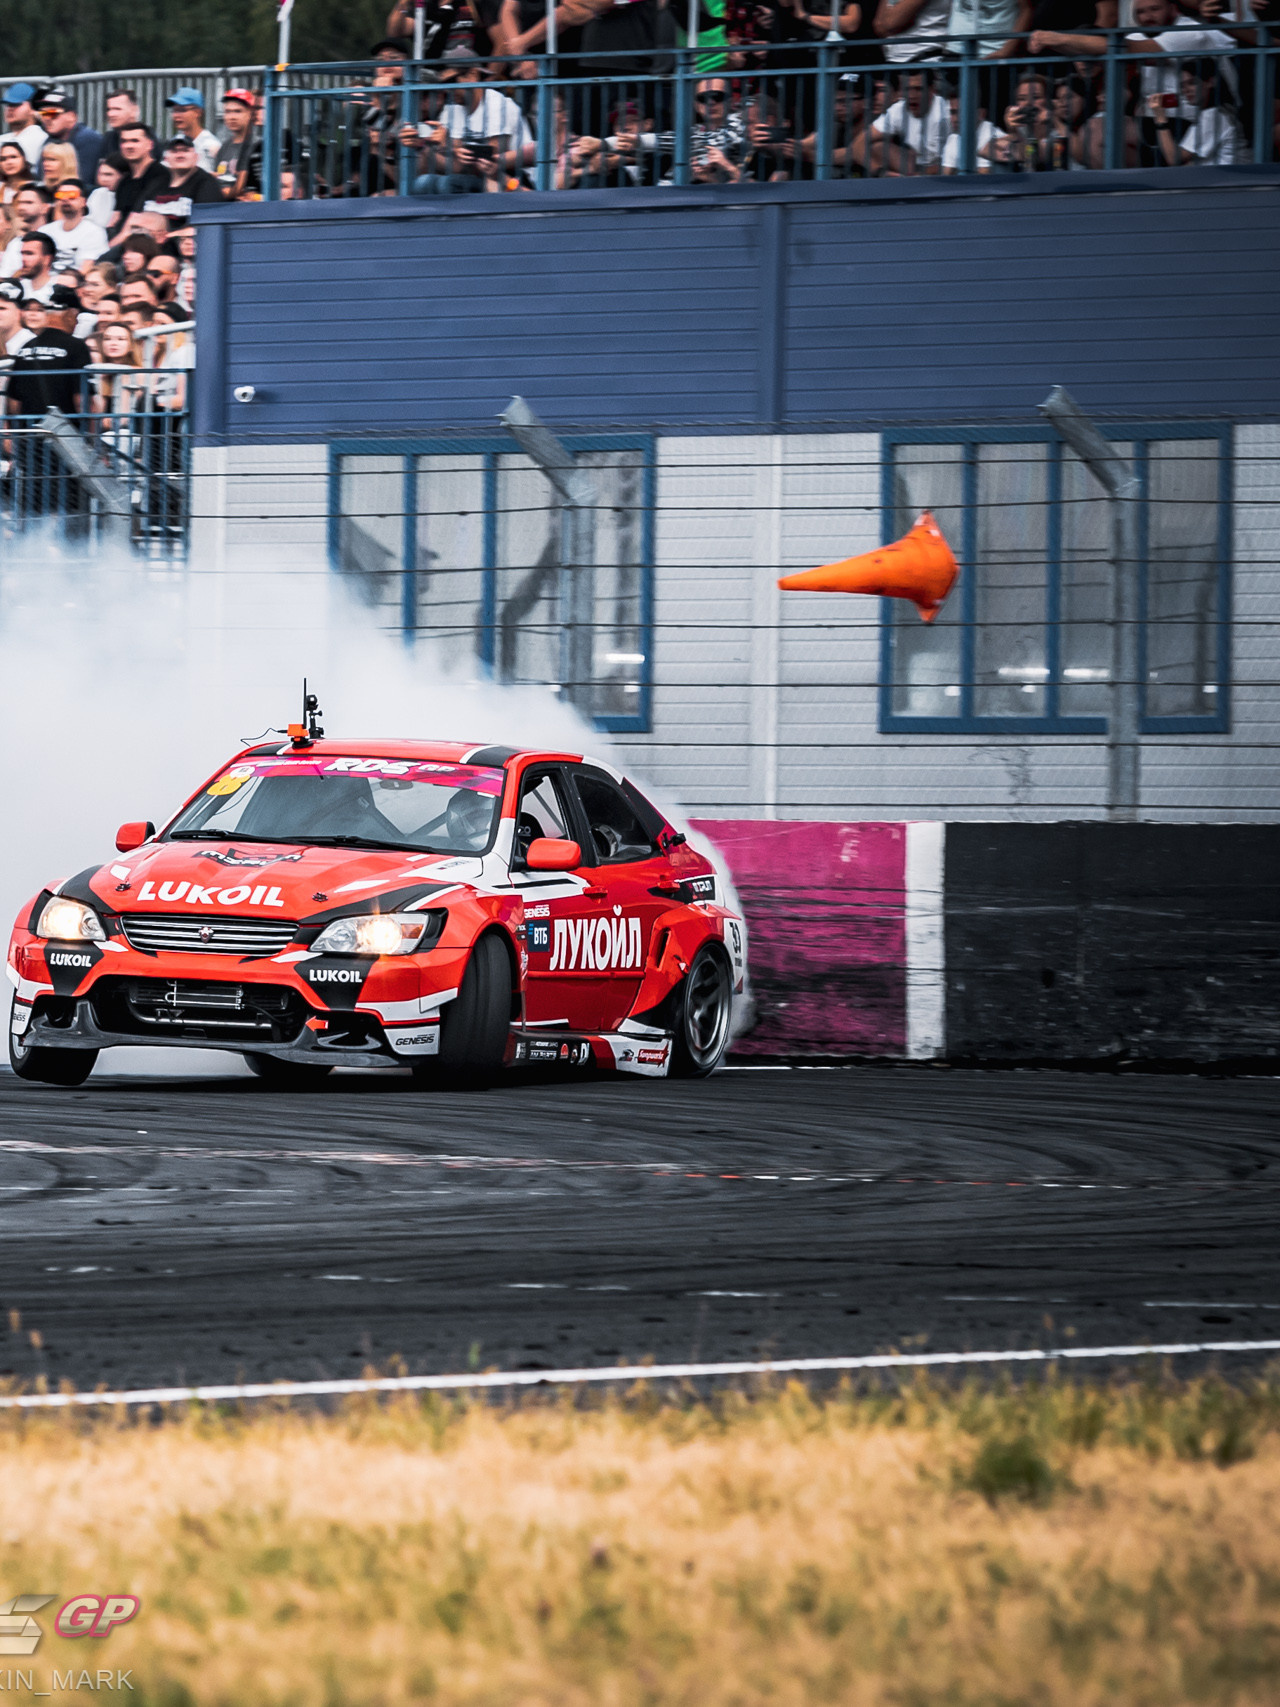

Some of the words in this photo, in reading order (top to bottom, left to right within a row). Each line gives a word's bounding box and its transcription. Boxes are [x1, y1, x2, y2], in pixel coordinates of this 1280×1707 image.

[323, 757, 421, 775] RDS
[136, 880, 285, 908] LUKOIL
[533, 926, 549, 945] ВТБ
[549, 904, 642, 971] ЛУКОЙЛ
[49, 952, 93, 968] LUKOIL
[309, 968, 363, 984] LUKOIL
[395, 1035, 435, 1046] GENESIS
